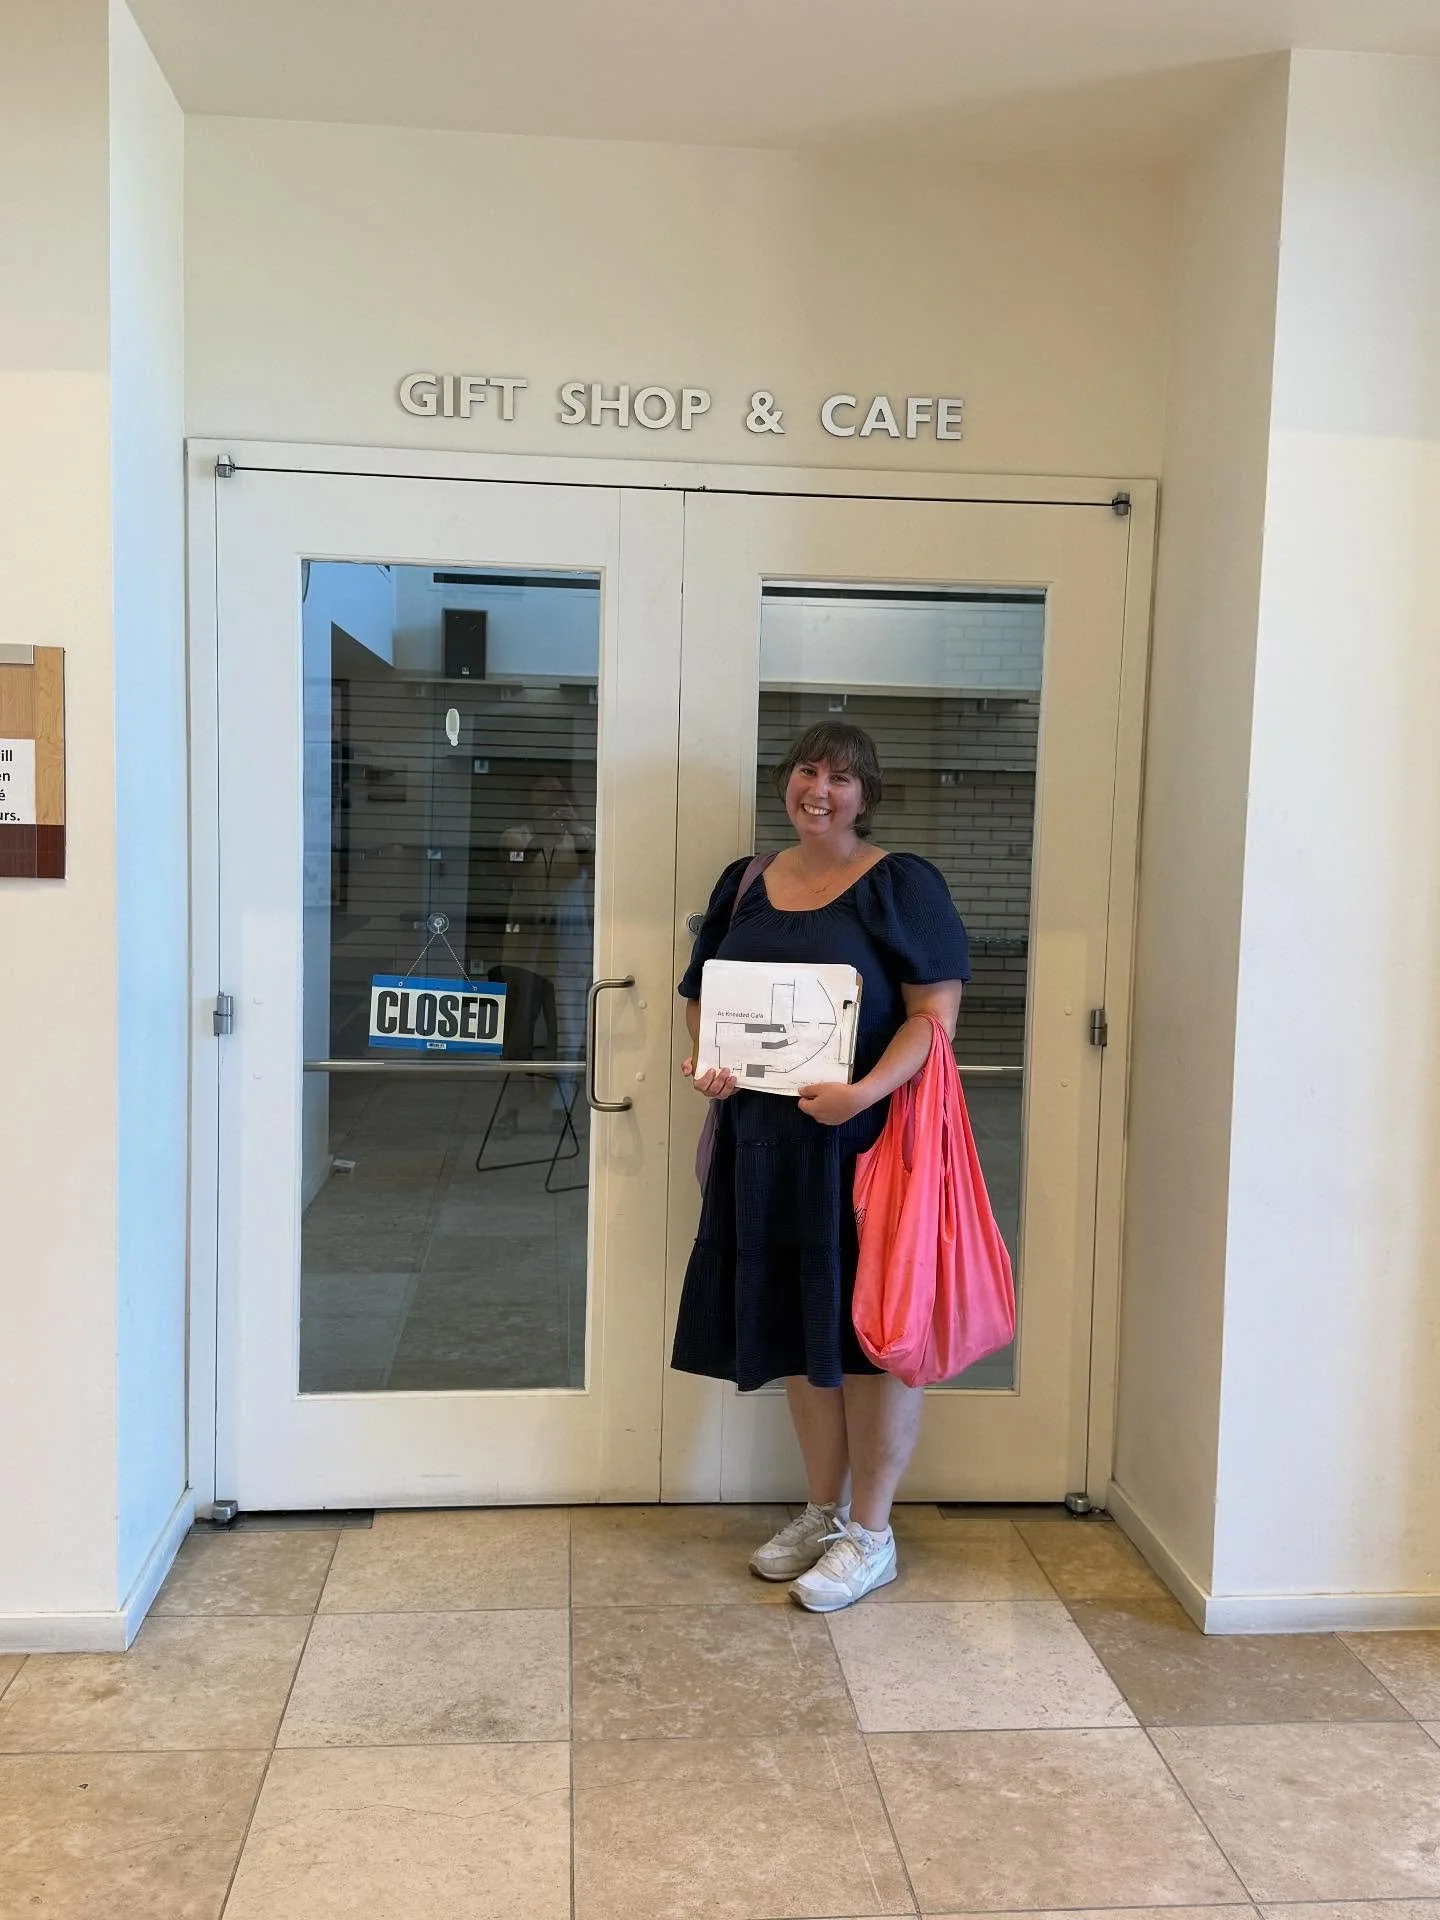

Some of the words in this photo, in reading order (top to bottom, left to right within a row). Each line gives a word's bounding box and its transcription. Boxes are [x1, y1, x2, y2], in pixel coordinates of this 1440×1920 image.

[399, 372, 528, 421] GIFT
[560, 382, 711, 431] SHOP
[745, 391, 786, 435] &
[820, 394, 965, 441] CAFE
[376, 990, 499, 1040] CLOSED
